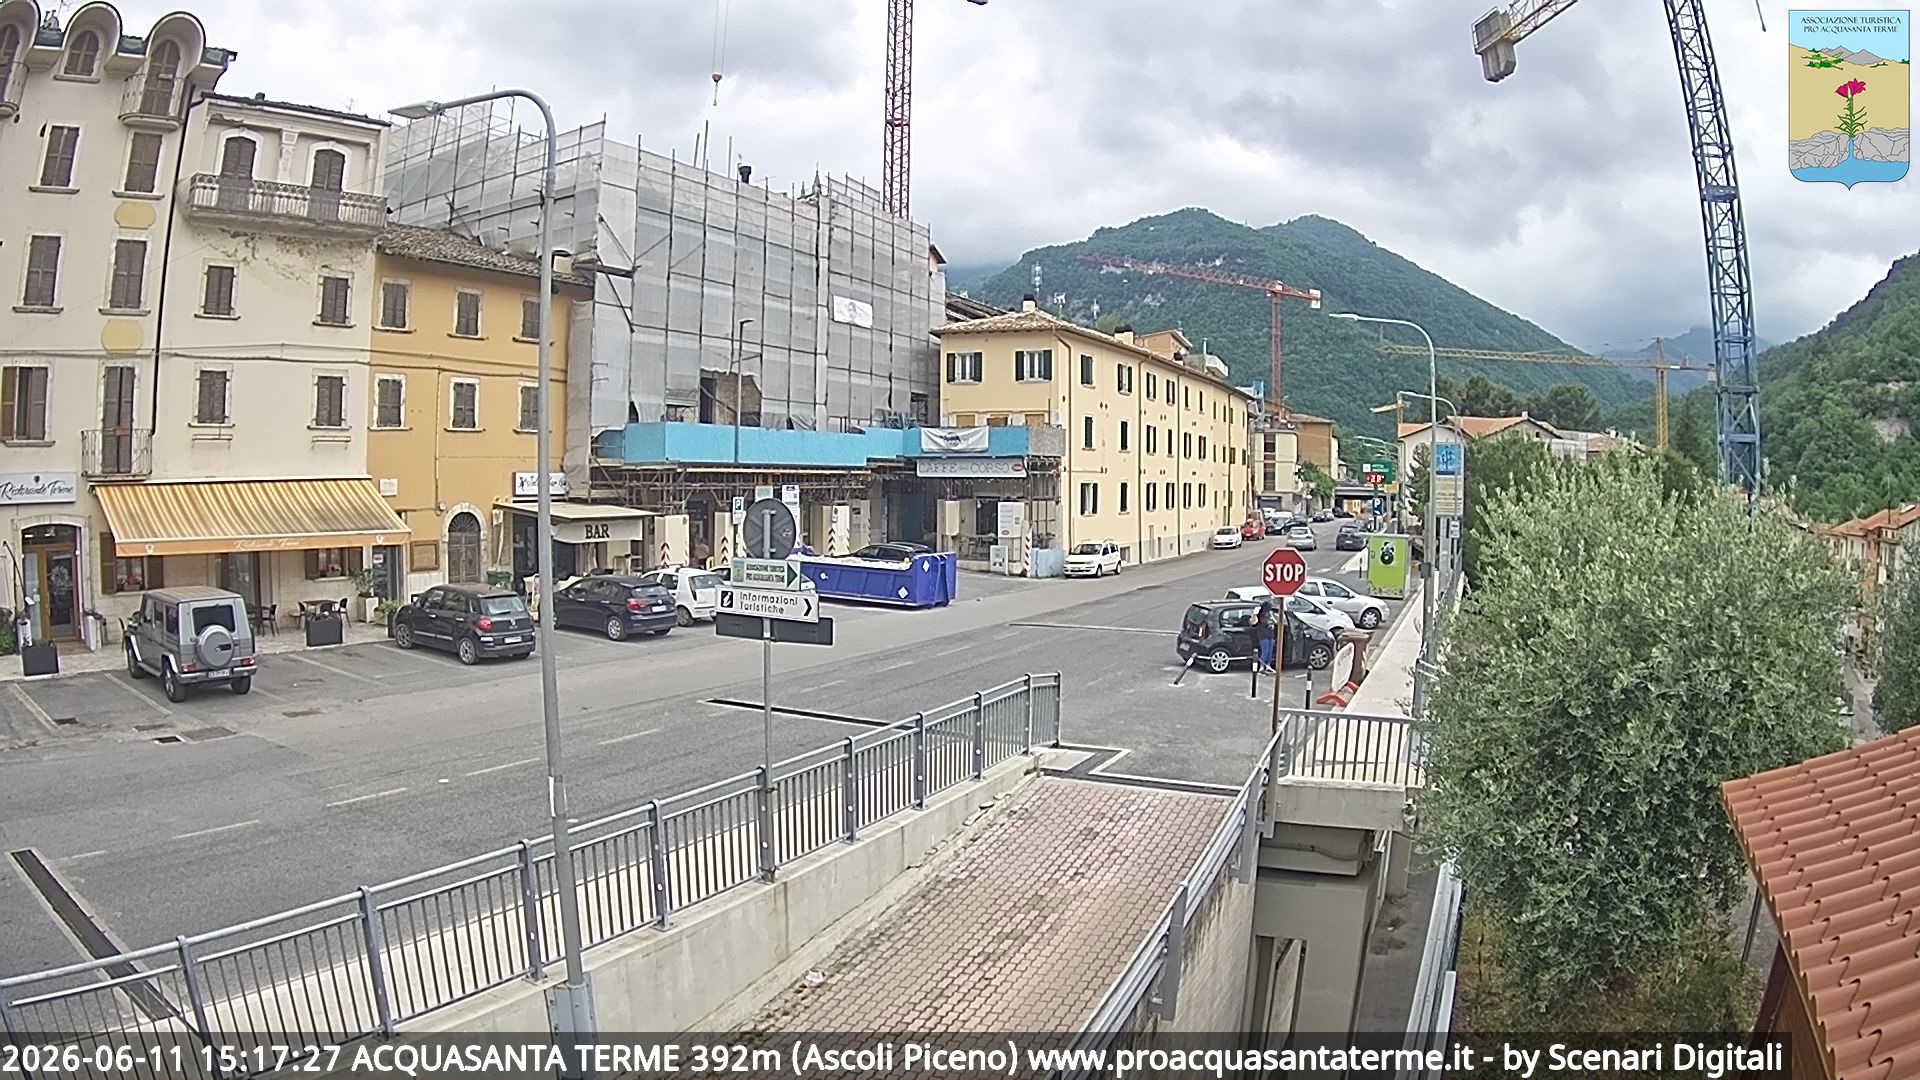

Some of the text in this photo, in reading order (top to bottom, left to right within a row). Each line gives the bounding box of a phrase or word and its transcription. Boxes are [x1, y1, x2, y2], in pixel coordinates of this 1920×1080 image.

[970, 462, 1010, 474] CORSO
[584, 523, 611, 540] BAR
[1265, 563, 1304, 582] STOP
[739, 591, 798, 605] Informazioni
[739, 601, 785, 614] Turistiche
